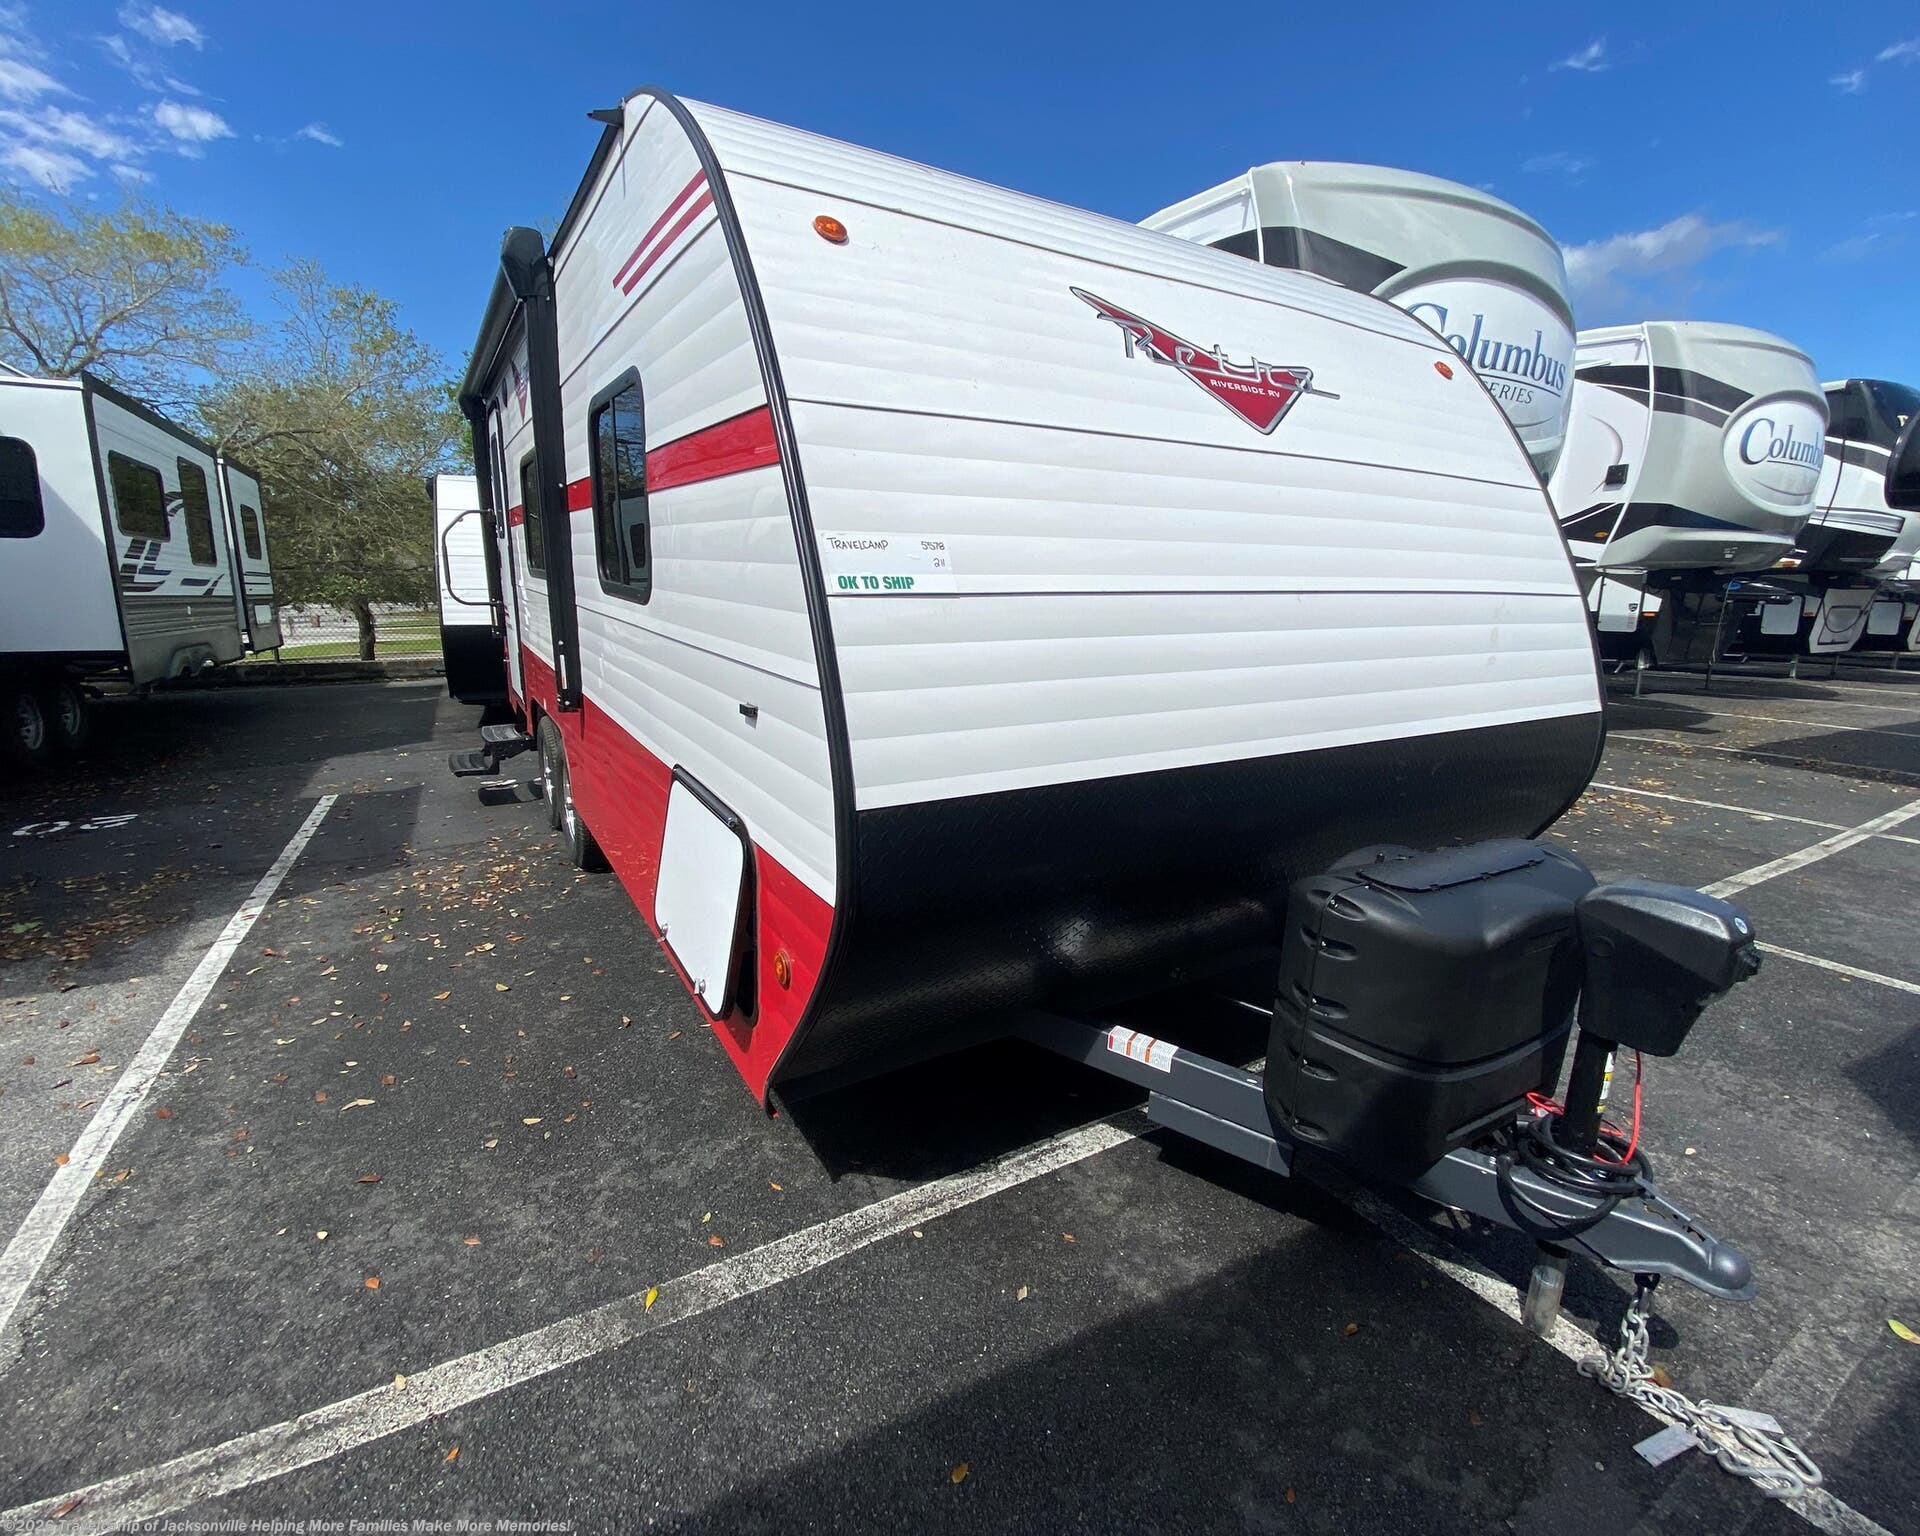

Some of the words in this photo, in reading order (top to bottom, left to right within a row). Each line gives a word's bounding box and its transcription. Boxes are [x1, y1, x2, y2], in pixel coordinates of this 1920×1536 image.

[1097, 313, 1341, 400] Retro
[1210, 379, 1266, 395] RIVERSIDE
[1267, 389, 1280, 398] RV
[1483, 380, 1534, 404] ERIES
[1740, 418, 1823, 468] Columb
[826, 537, 889, 551] TRAVELCAMP
[921, 540, 946, 551] 5578
[838, 575, 859, 590] OK
[860, 575, 880, 590] TO
[882, 576, 915, 590] SHIP
